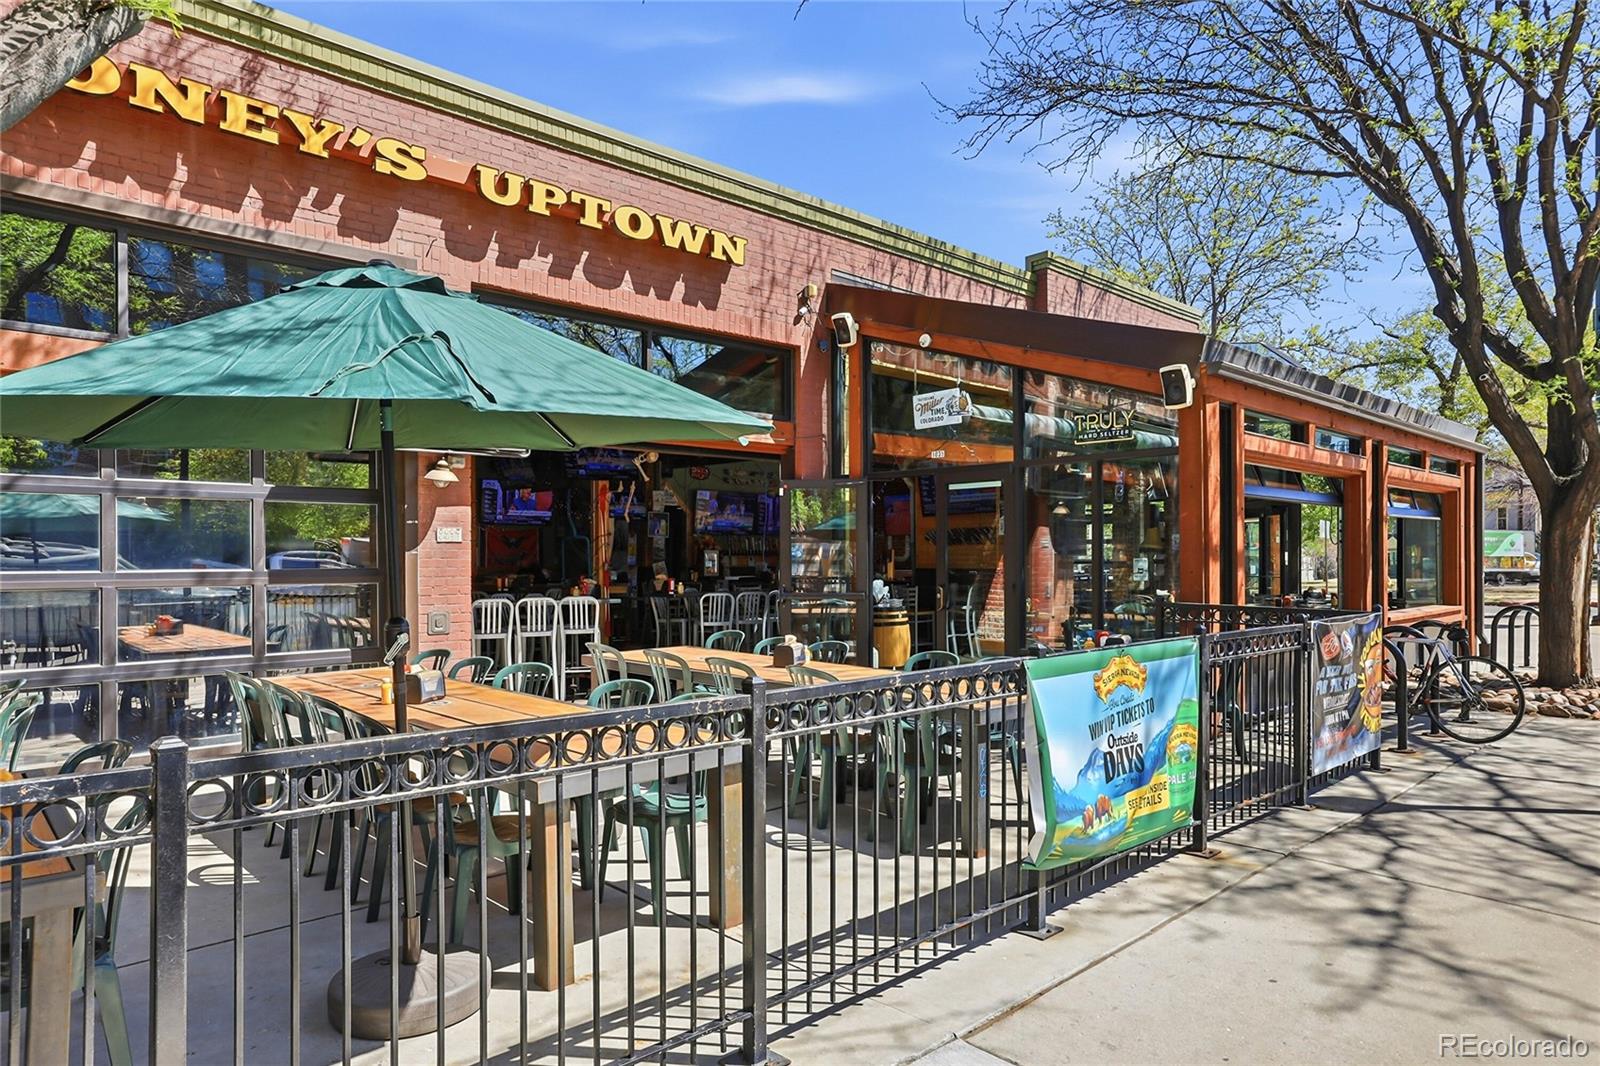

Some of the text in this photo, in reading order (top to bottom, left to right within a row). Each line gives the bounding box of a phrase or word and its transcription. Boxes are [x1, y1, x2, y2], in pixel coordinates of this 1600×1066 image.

[475, 163, 749, 266] UPTOWN
[915, 396, 944, 417] Miller
[920, 415, 945, 425] COLORADO
[1074, 409, 1134, 432] TRULY
[1078, 429, 1130, 440] HARD SELTZER
[1102, 667, 1140, 688] SIERRA NEVADA
[1088, 719, 1104, 742] WIN
[1115, 701, 1146, 728] TICKETS
[1144, 697, 1156, 715] TO
[1107, 731, 1139, 750] Outside
[1103, 743, 1145, 785] DAYS
[1168, 772, 1187, 785] PALE
[1137, 792, 1163, 810] ETAILS
